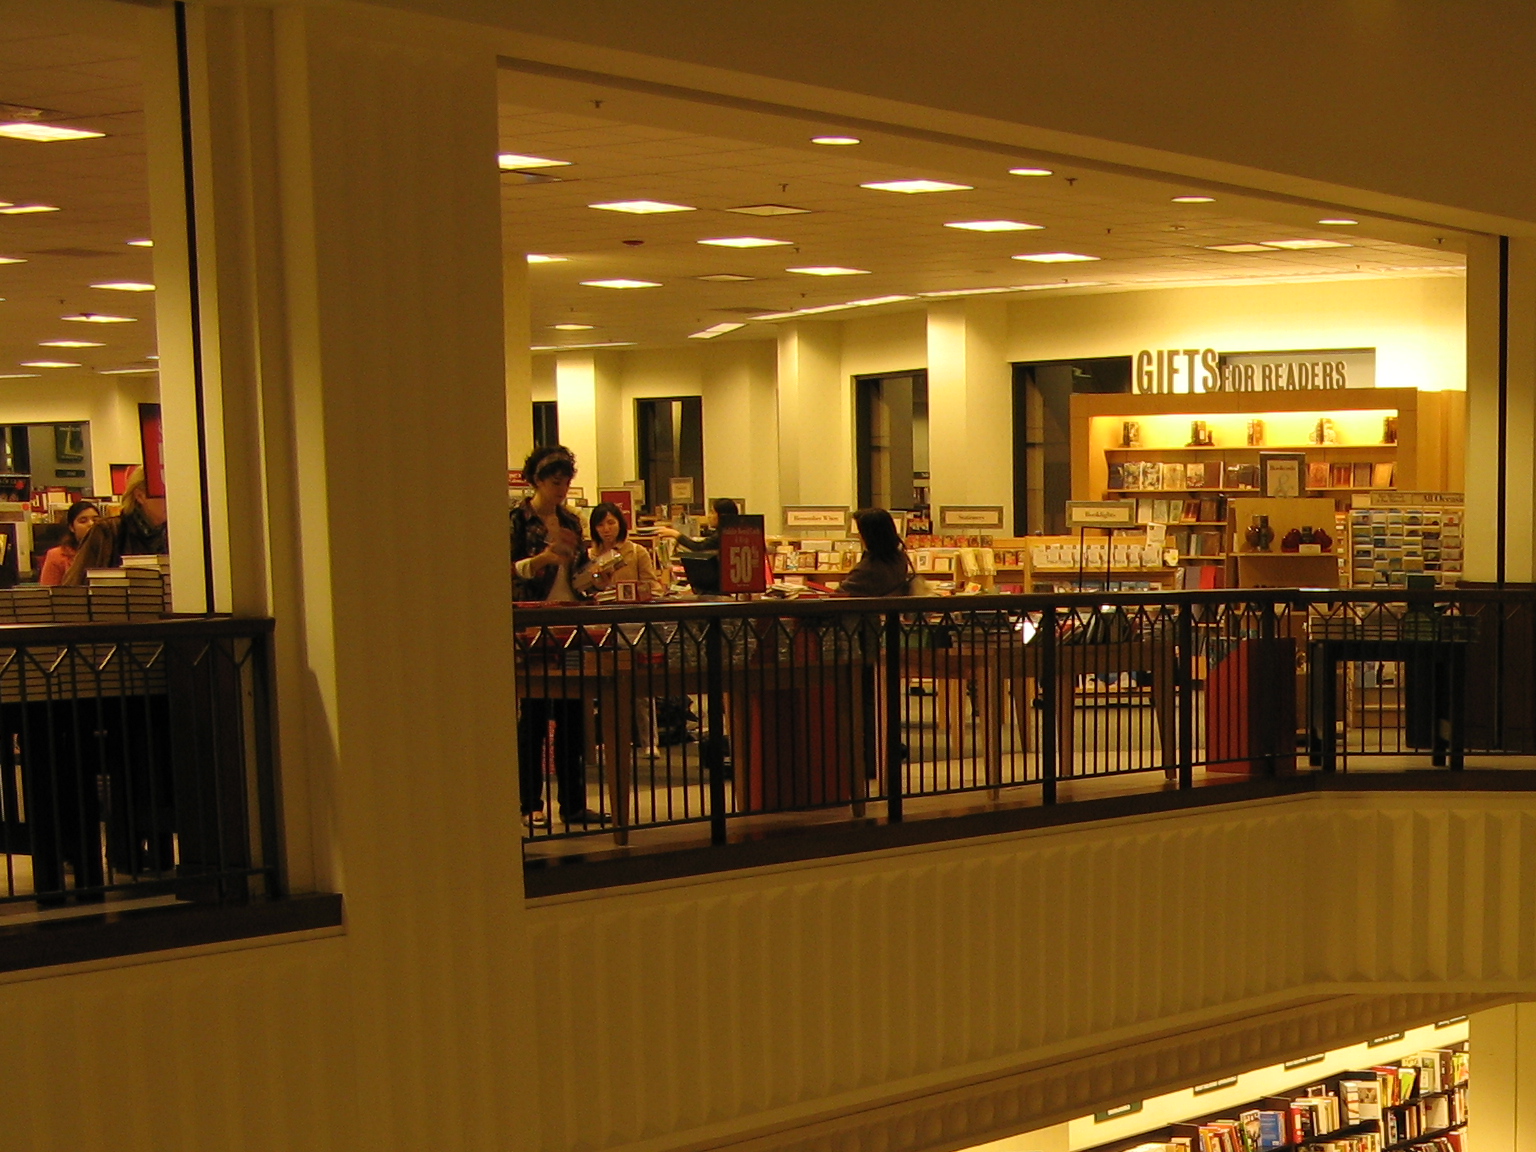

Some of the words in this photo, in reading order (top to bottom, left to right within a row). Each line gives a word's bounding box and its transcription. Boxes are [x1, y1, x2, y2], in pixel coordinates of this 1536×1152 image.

[1136, 348, 1221, 395] GIFTS
[1222, 364, 1256, 393] FOR
[1262, 361, 1346, 392] READERS
